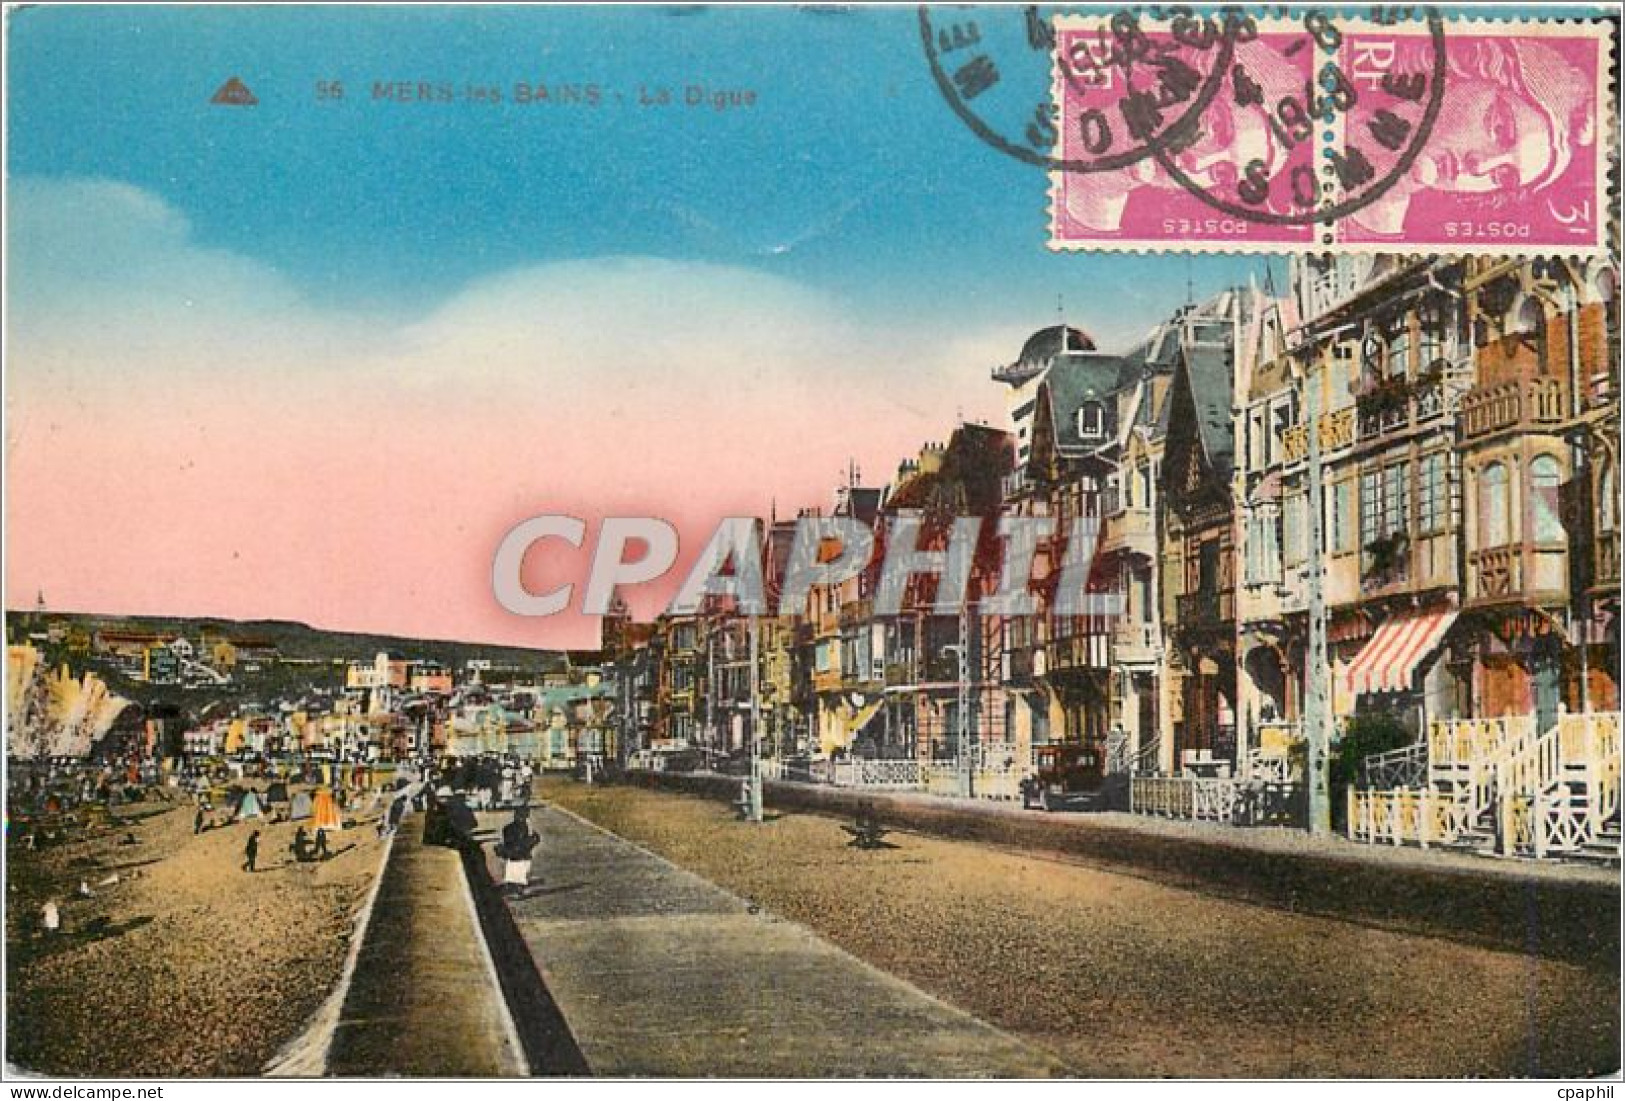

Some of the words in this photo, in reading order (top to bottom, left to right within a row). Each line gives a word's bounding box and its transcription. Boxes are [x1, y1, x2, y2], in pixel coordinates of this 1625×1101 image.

[513, 82, 601, 107] BAINS
[684, 85, 759, 111] Digue
[1267, 64, 1358, 151] 1948
[1238, 72, 1426, 206] SOMME
[1163, 217, 1248, 234] POSTES
[1444, 222, 1531, 238] POSTES
